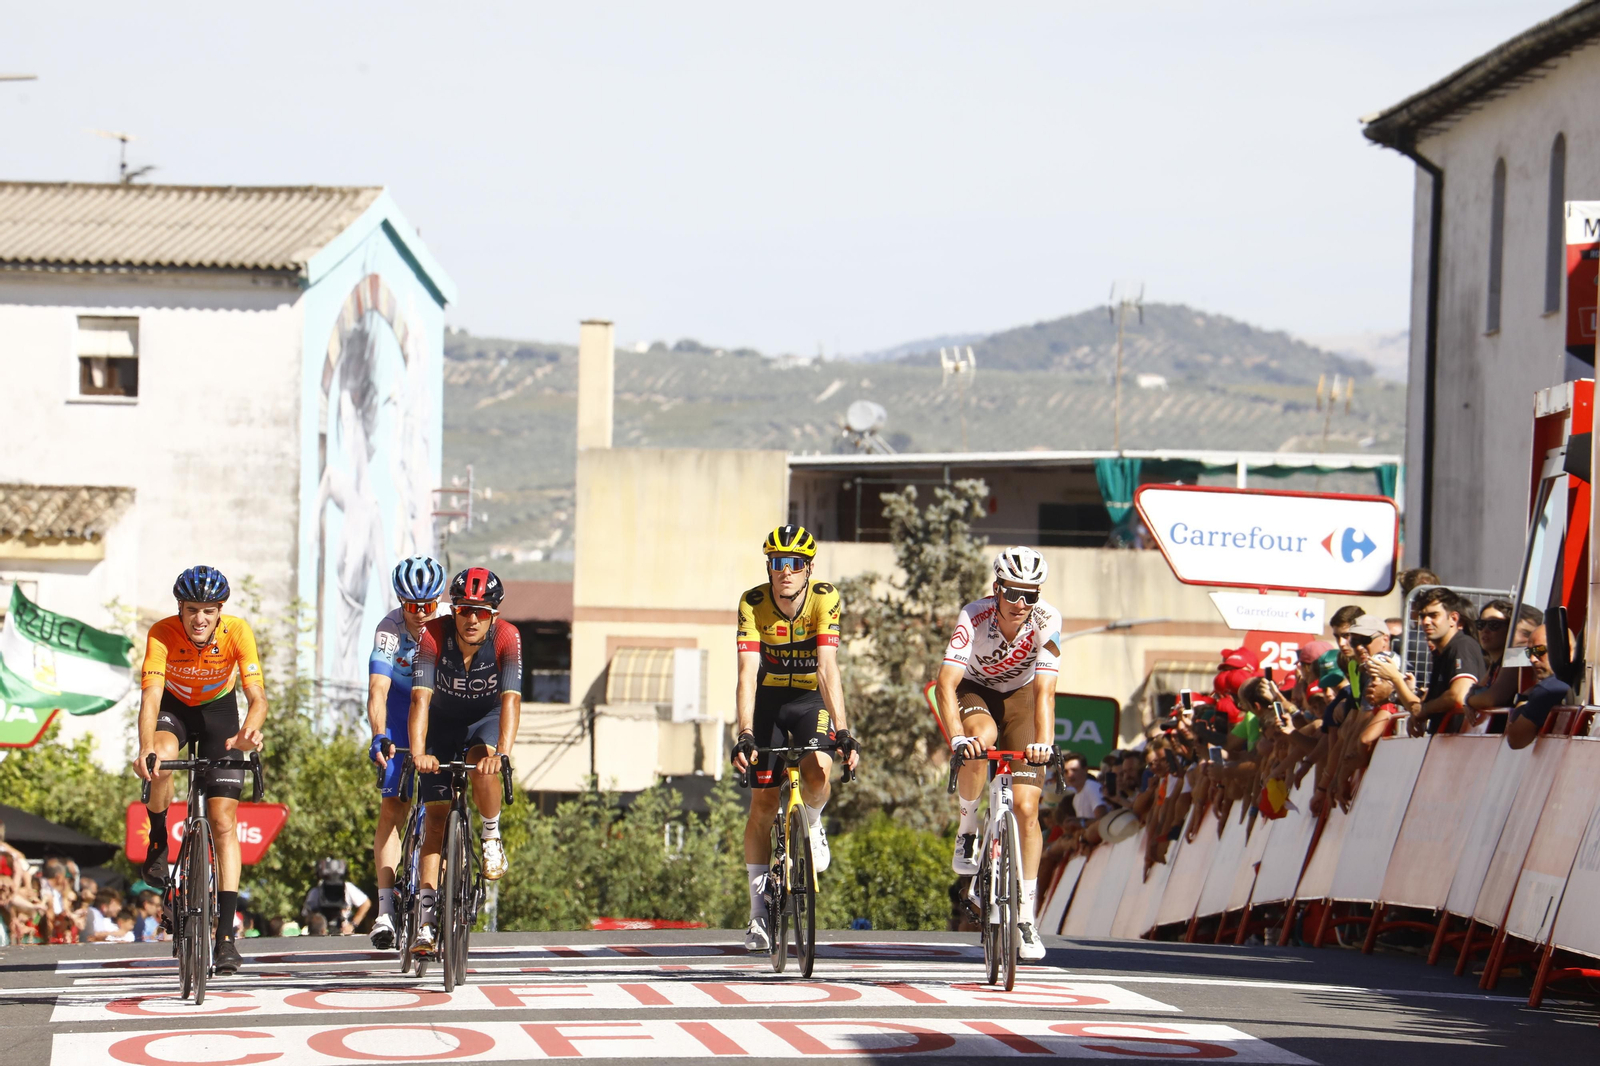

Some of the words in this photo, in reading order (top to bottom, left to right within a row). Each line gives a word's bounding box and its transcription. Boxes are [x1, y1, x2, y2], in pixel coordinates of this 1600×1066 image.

[1170, 522, 1308, 552] Carrefour
[1236, 605, 1290, 619] Carrefour
[1260, 640, 1300, 672] 25
[436, 669, 498, 692] INEOS
[816, 709, 830, 736] JUMBO
[1001, 776, 1009, 806] BMC
[105, 981, 1111, 1016] COFIDIS
[108, 1020, 1238, 1066] COFIDIS
